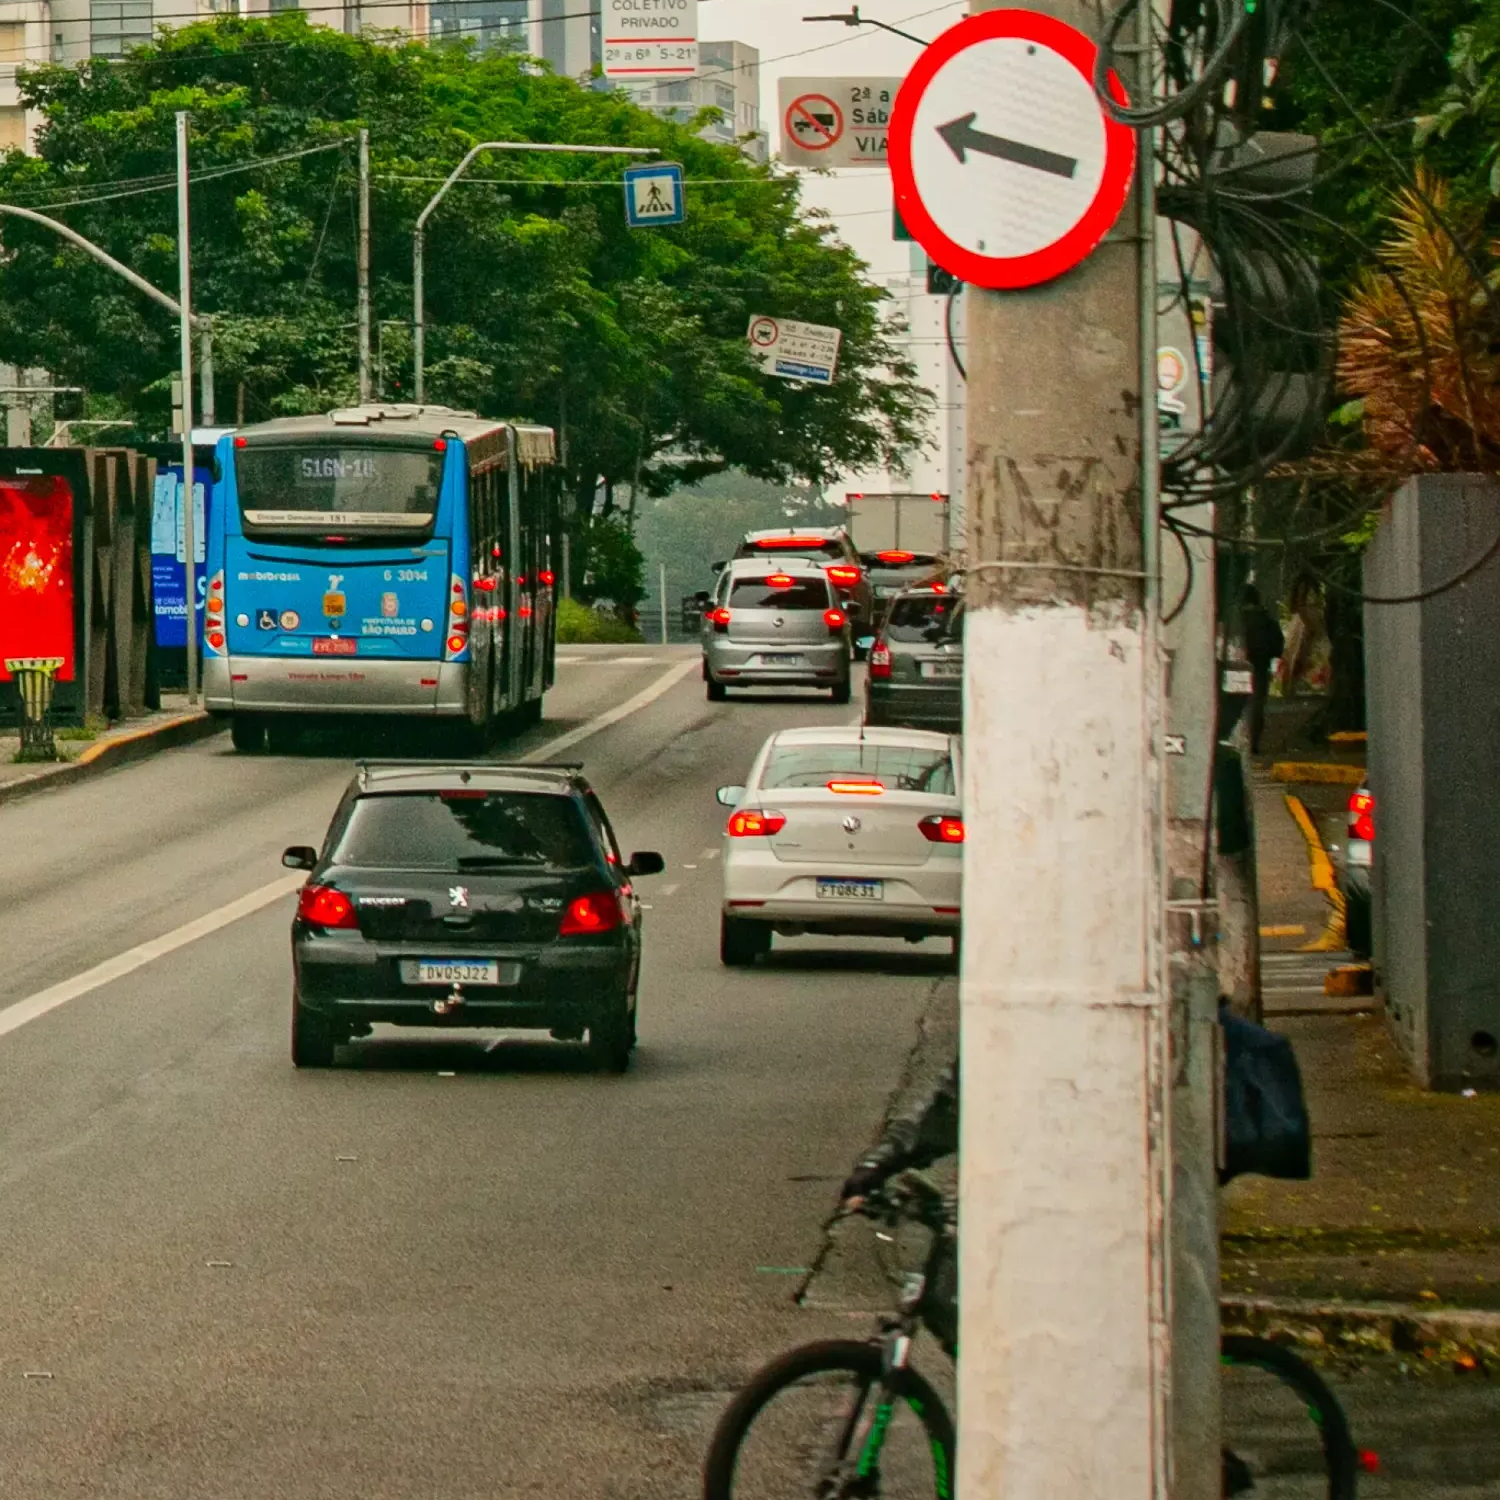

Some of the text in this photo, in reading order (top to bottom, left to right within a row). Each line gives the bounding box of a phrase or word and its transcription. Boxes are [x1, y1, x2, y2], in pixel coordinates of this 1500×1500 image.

[612, 0, 687, 11] COLETIVO
[621, 16, 679, 28] PRIVADO
[624, 51, 632, 60] a
[879, 90, 889, 102] a
